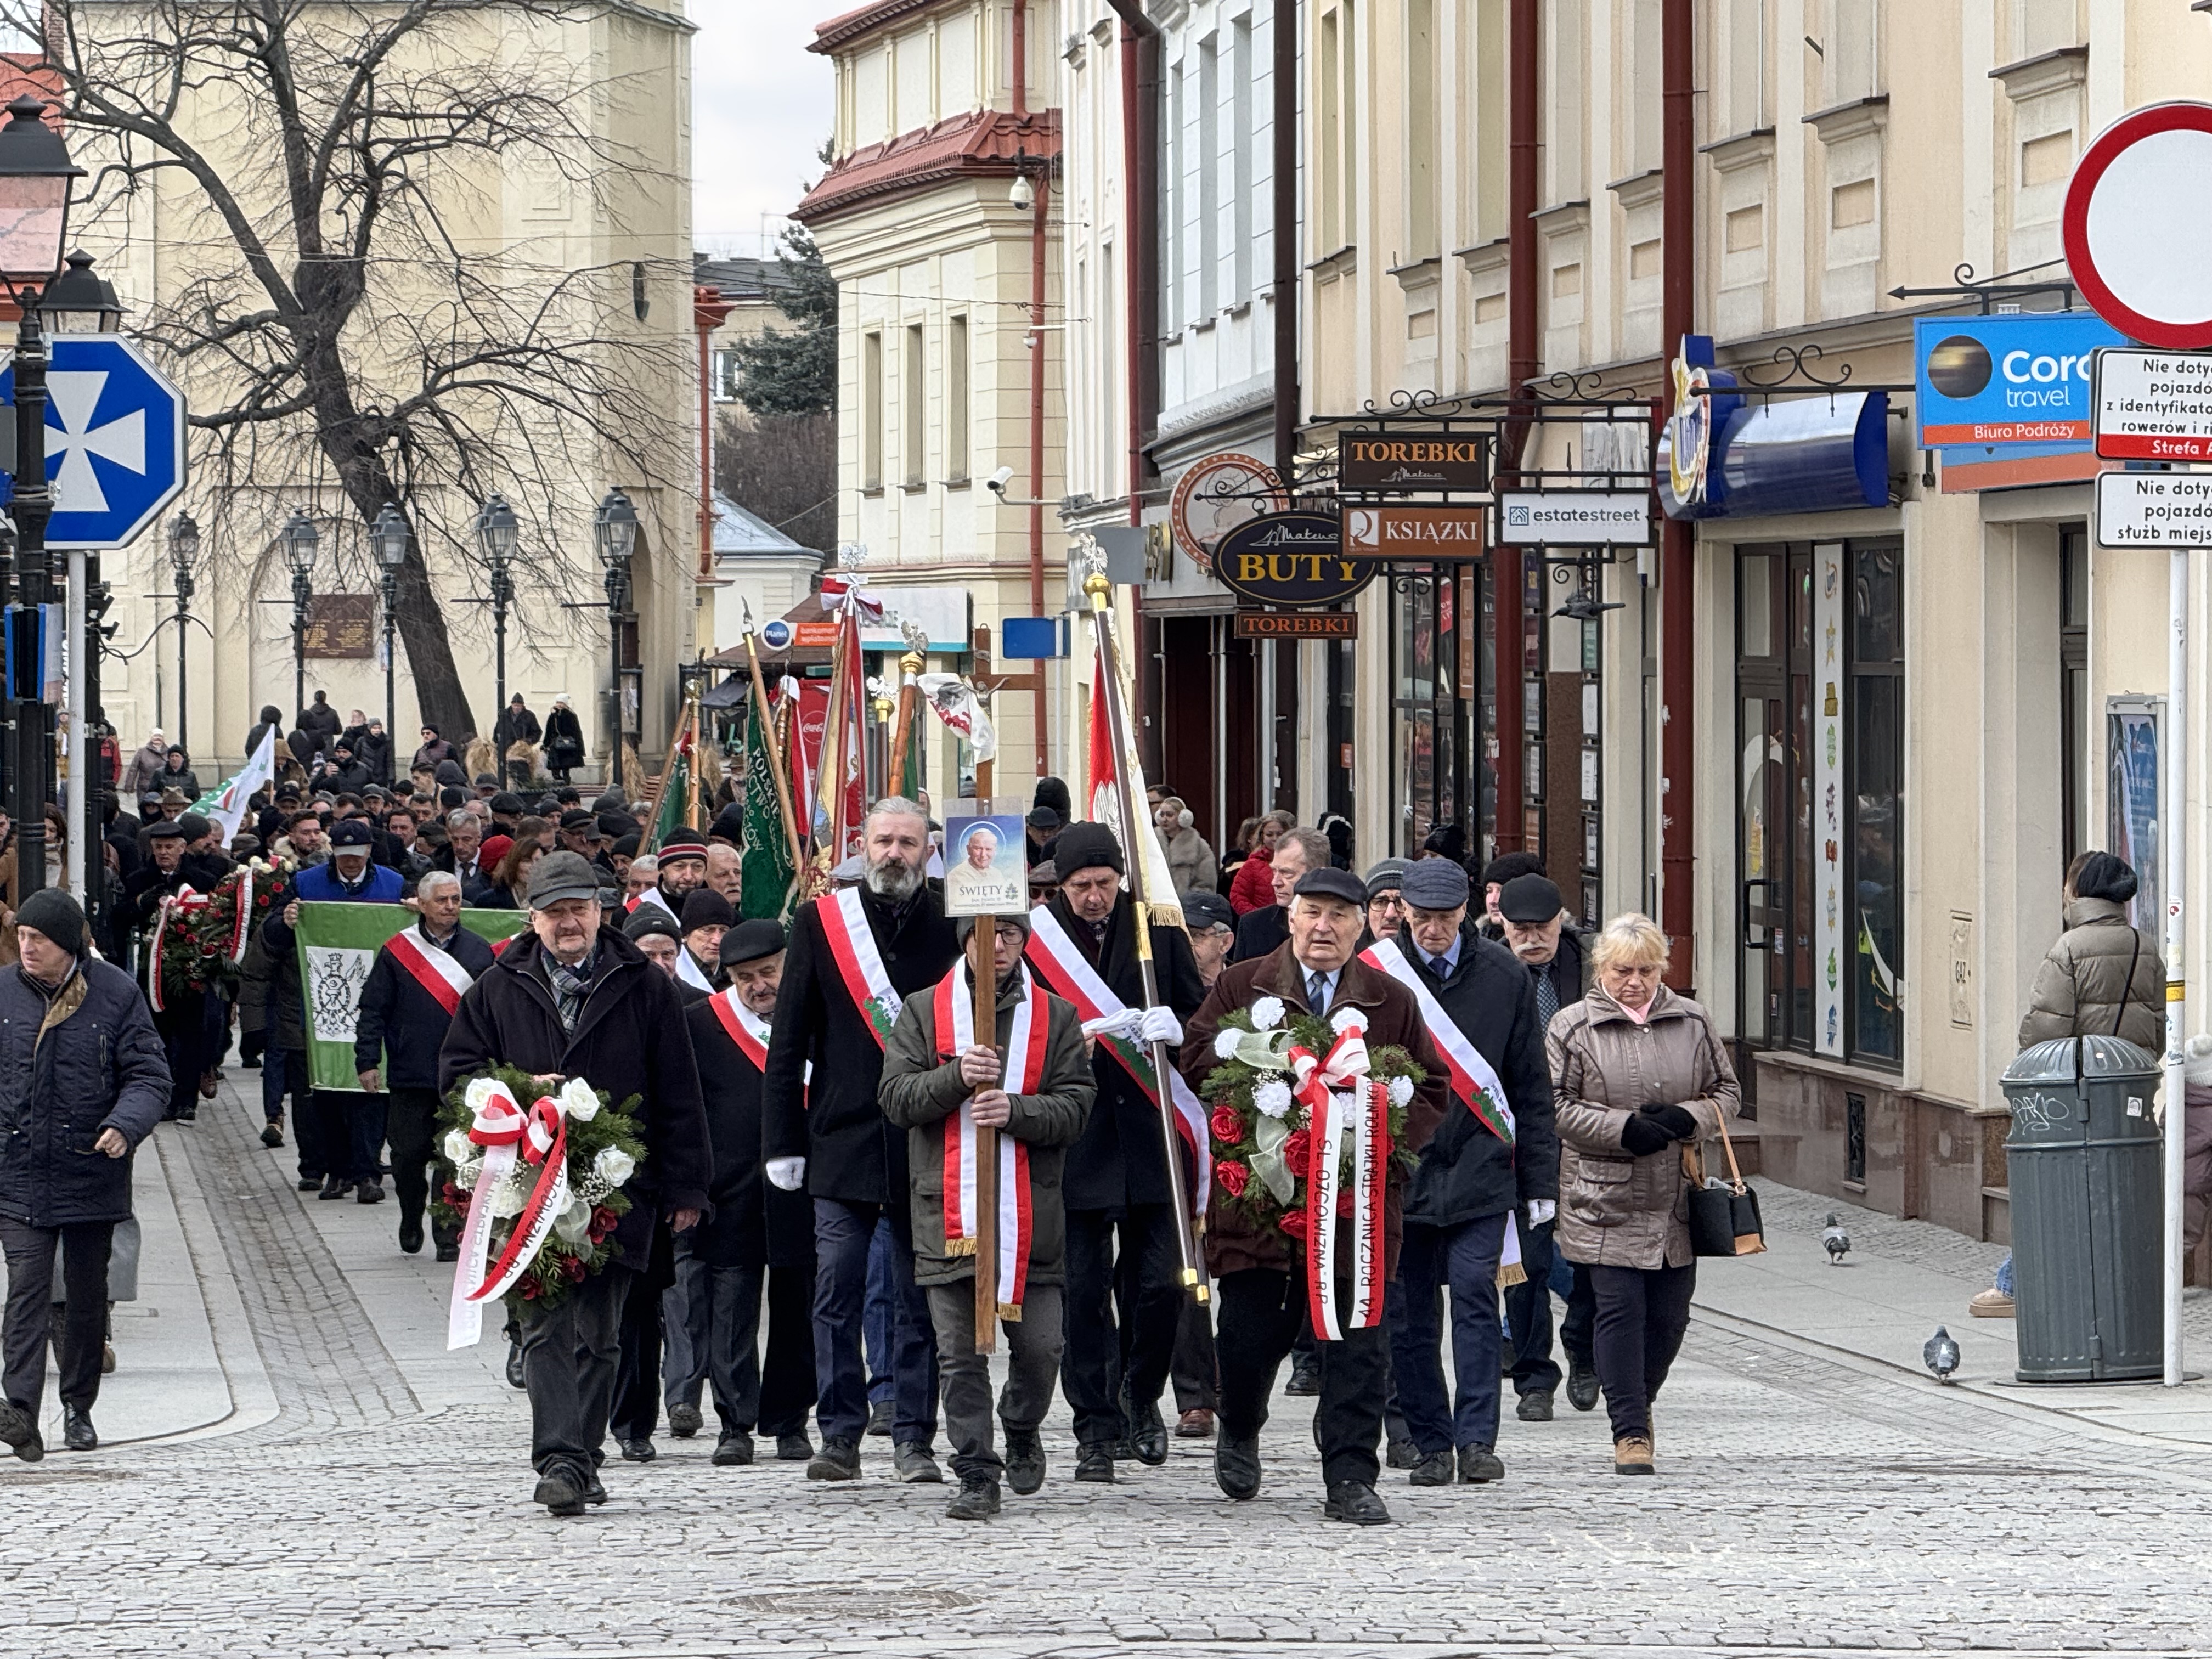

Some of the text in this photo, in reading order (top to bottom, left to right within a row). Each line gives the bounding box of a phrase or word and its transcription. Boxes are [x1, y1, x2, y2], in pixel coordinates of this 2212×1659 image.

[2143, 359, 2212, 378] Nie doty
[2007, 386, 2070, 407] travel
[2107, 402, 2113, 411] z
[1975, 423, 2075, 438] Biuro Podróży
[2121, 419, 2186, 433] rowerów
[2193, 421, 2197, 434] i
[1352, 442, 1477, 462] TOREBKI
[2152, 439, 2199, 455] Strefa
[2137, 480, 2212, 500] Nie doty
[1533, 509, 1640, 522] estatestreet
[1385, 521, 1477, 544] KSIĄŻKI
[2118, 524, 2160, 539] służb
[1237, 554, 1357, 582] BUTY
[1244, 618, 1349, 632] TOREBKI
[753, 746, 780, 820] POLSKIE
[960, 884, 1003, 896] ŚWIĘTY
[1362, 1144, 1379, 1198] STRAJKU
[1359, 1197, 1378, 1287] ROCZNICA
[1314, 1279, 1329, 1305] RP
[1359, 1296, 1376, 1319] 44
